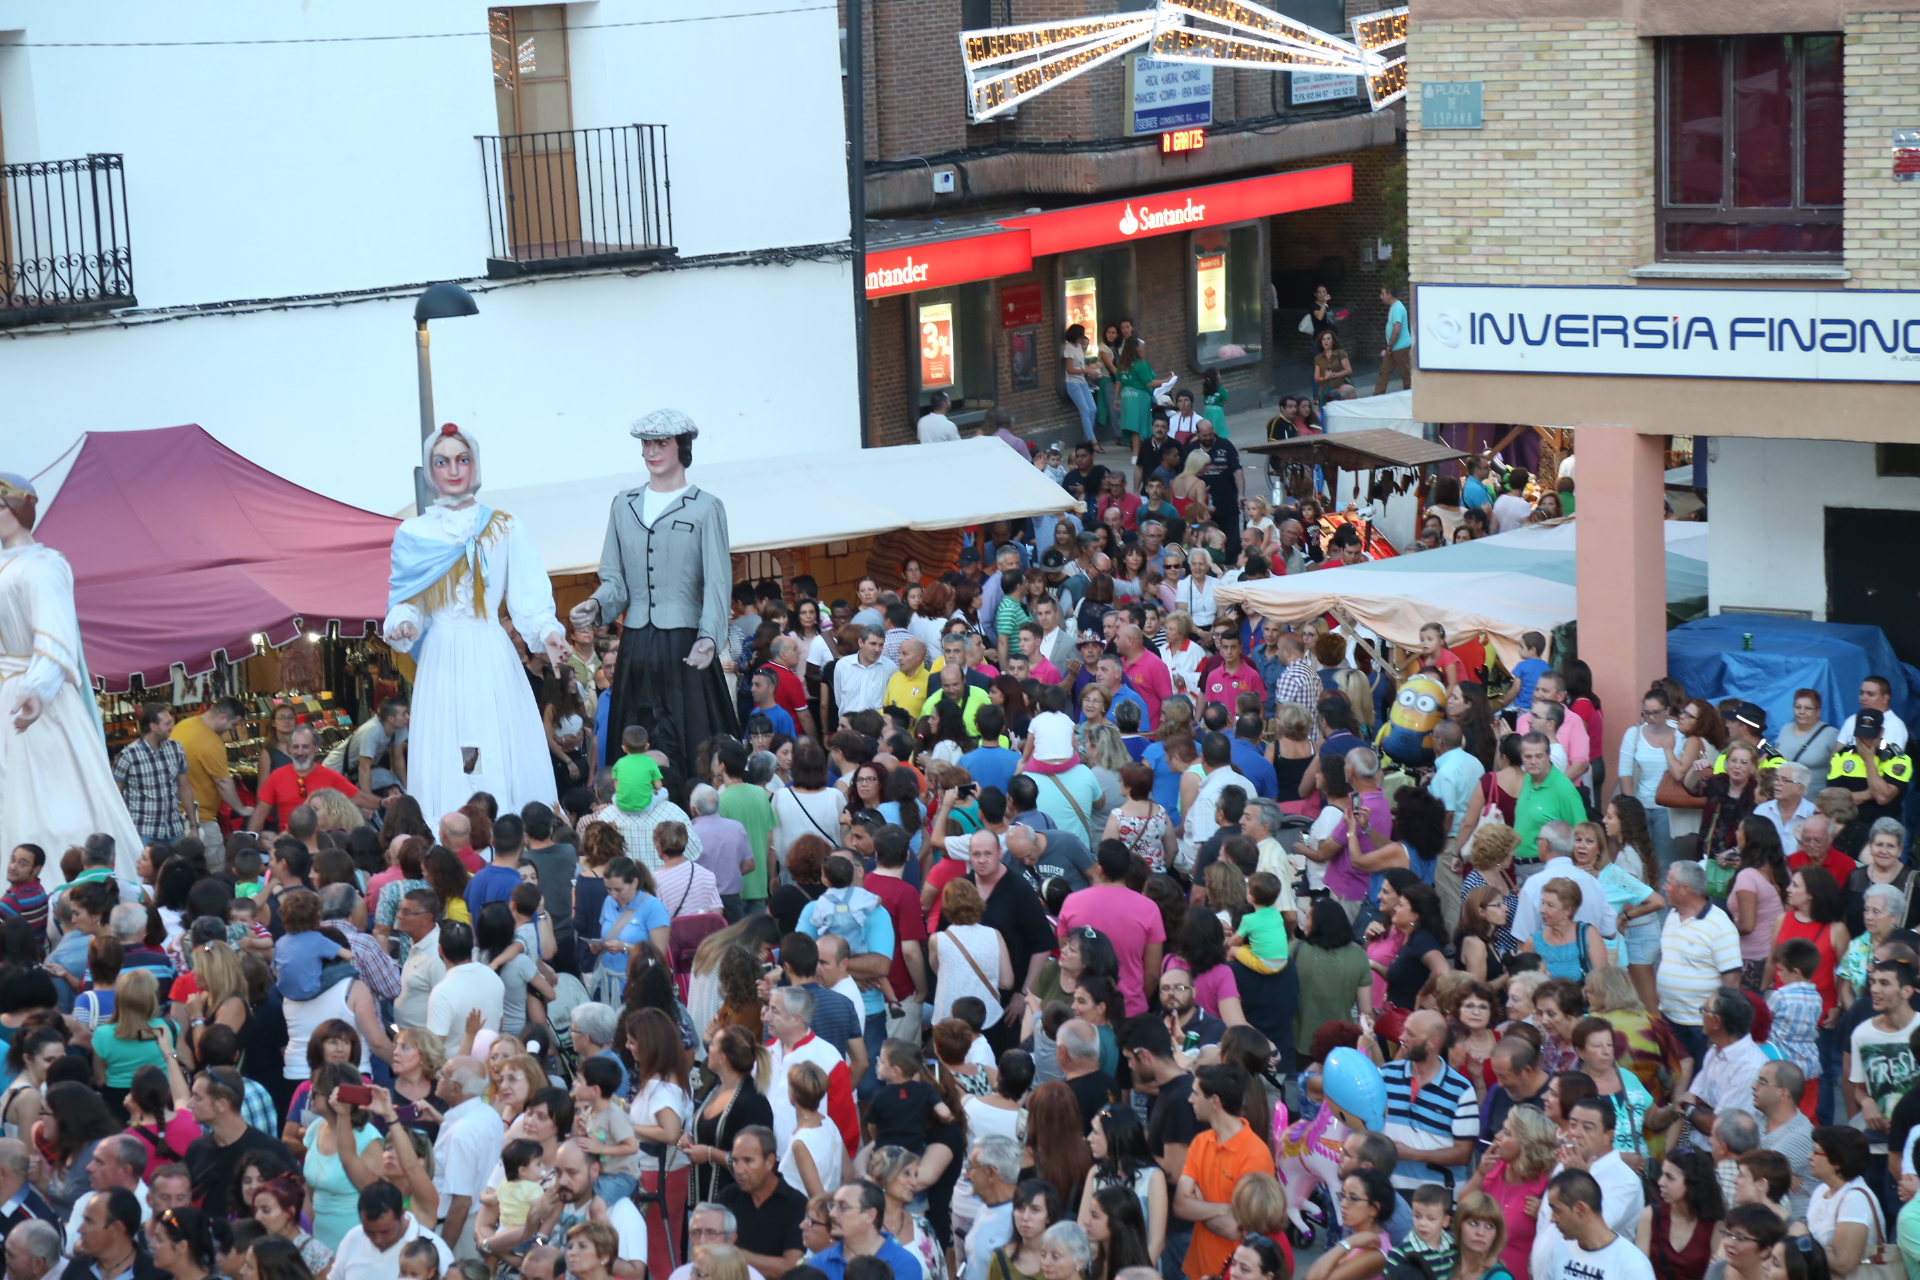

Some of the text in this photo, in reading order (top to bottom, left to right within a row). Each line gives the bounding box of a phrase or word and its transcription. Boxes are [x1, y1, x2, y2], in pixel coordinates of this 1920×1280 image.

[1436, 84, 1470, 95] PLAZA
[1433, 110, 1472, 125] ESPAÑA
[1173, 129, 1204, 151] GRATIS
[1140, 198, 1205, 230] Santander
[1038, 864, 1064, 877] BRITISH
